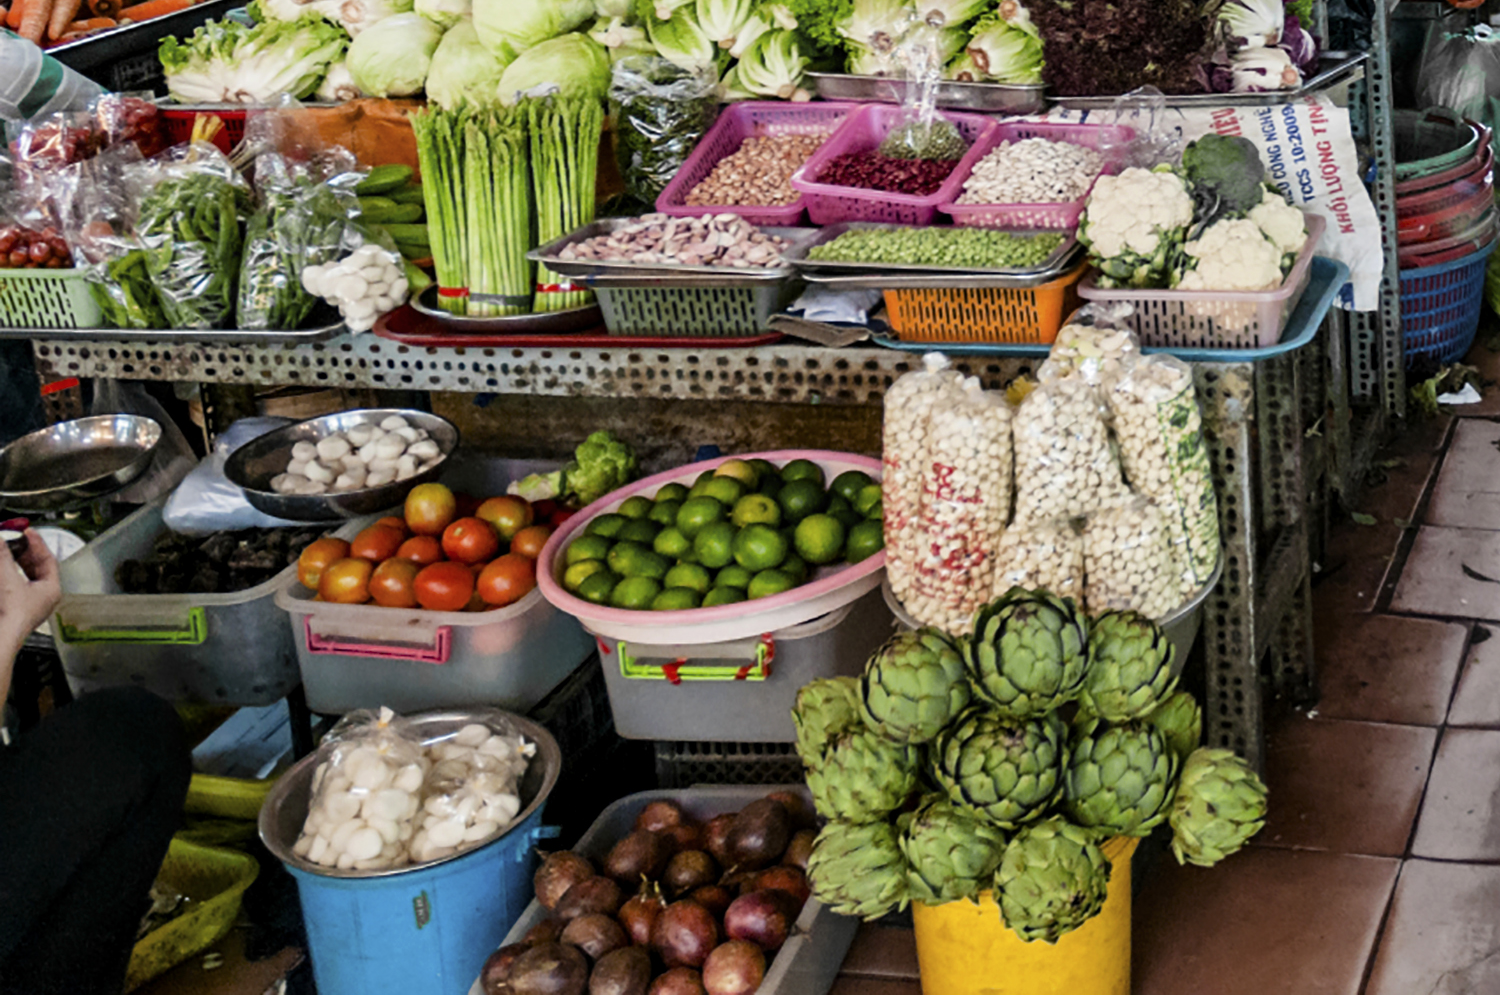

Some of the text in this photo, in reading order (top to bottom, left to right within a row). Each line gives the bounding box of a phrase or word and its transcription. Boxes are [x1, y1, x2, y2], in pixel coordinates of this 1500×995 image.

[1266, 144, 1288, 179] CÔNG
[1316, 140, 1344, 196] LƯỢNG
[1296, 168, 1315, 203] TCCS
[1326, 196, 1356, 234] KHỐI
